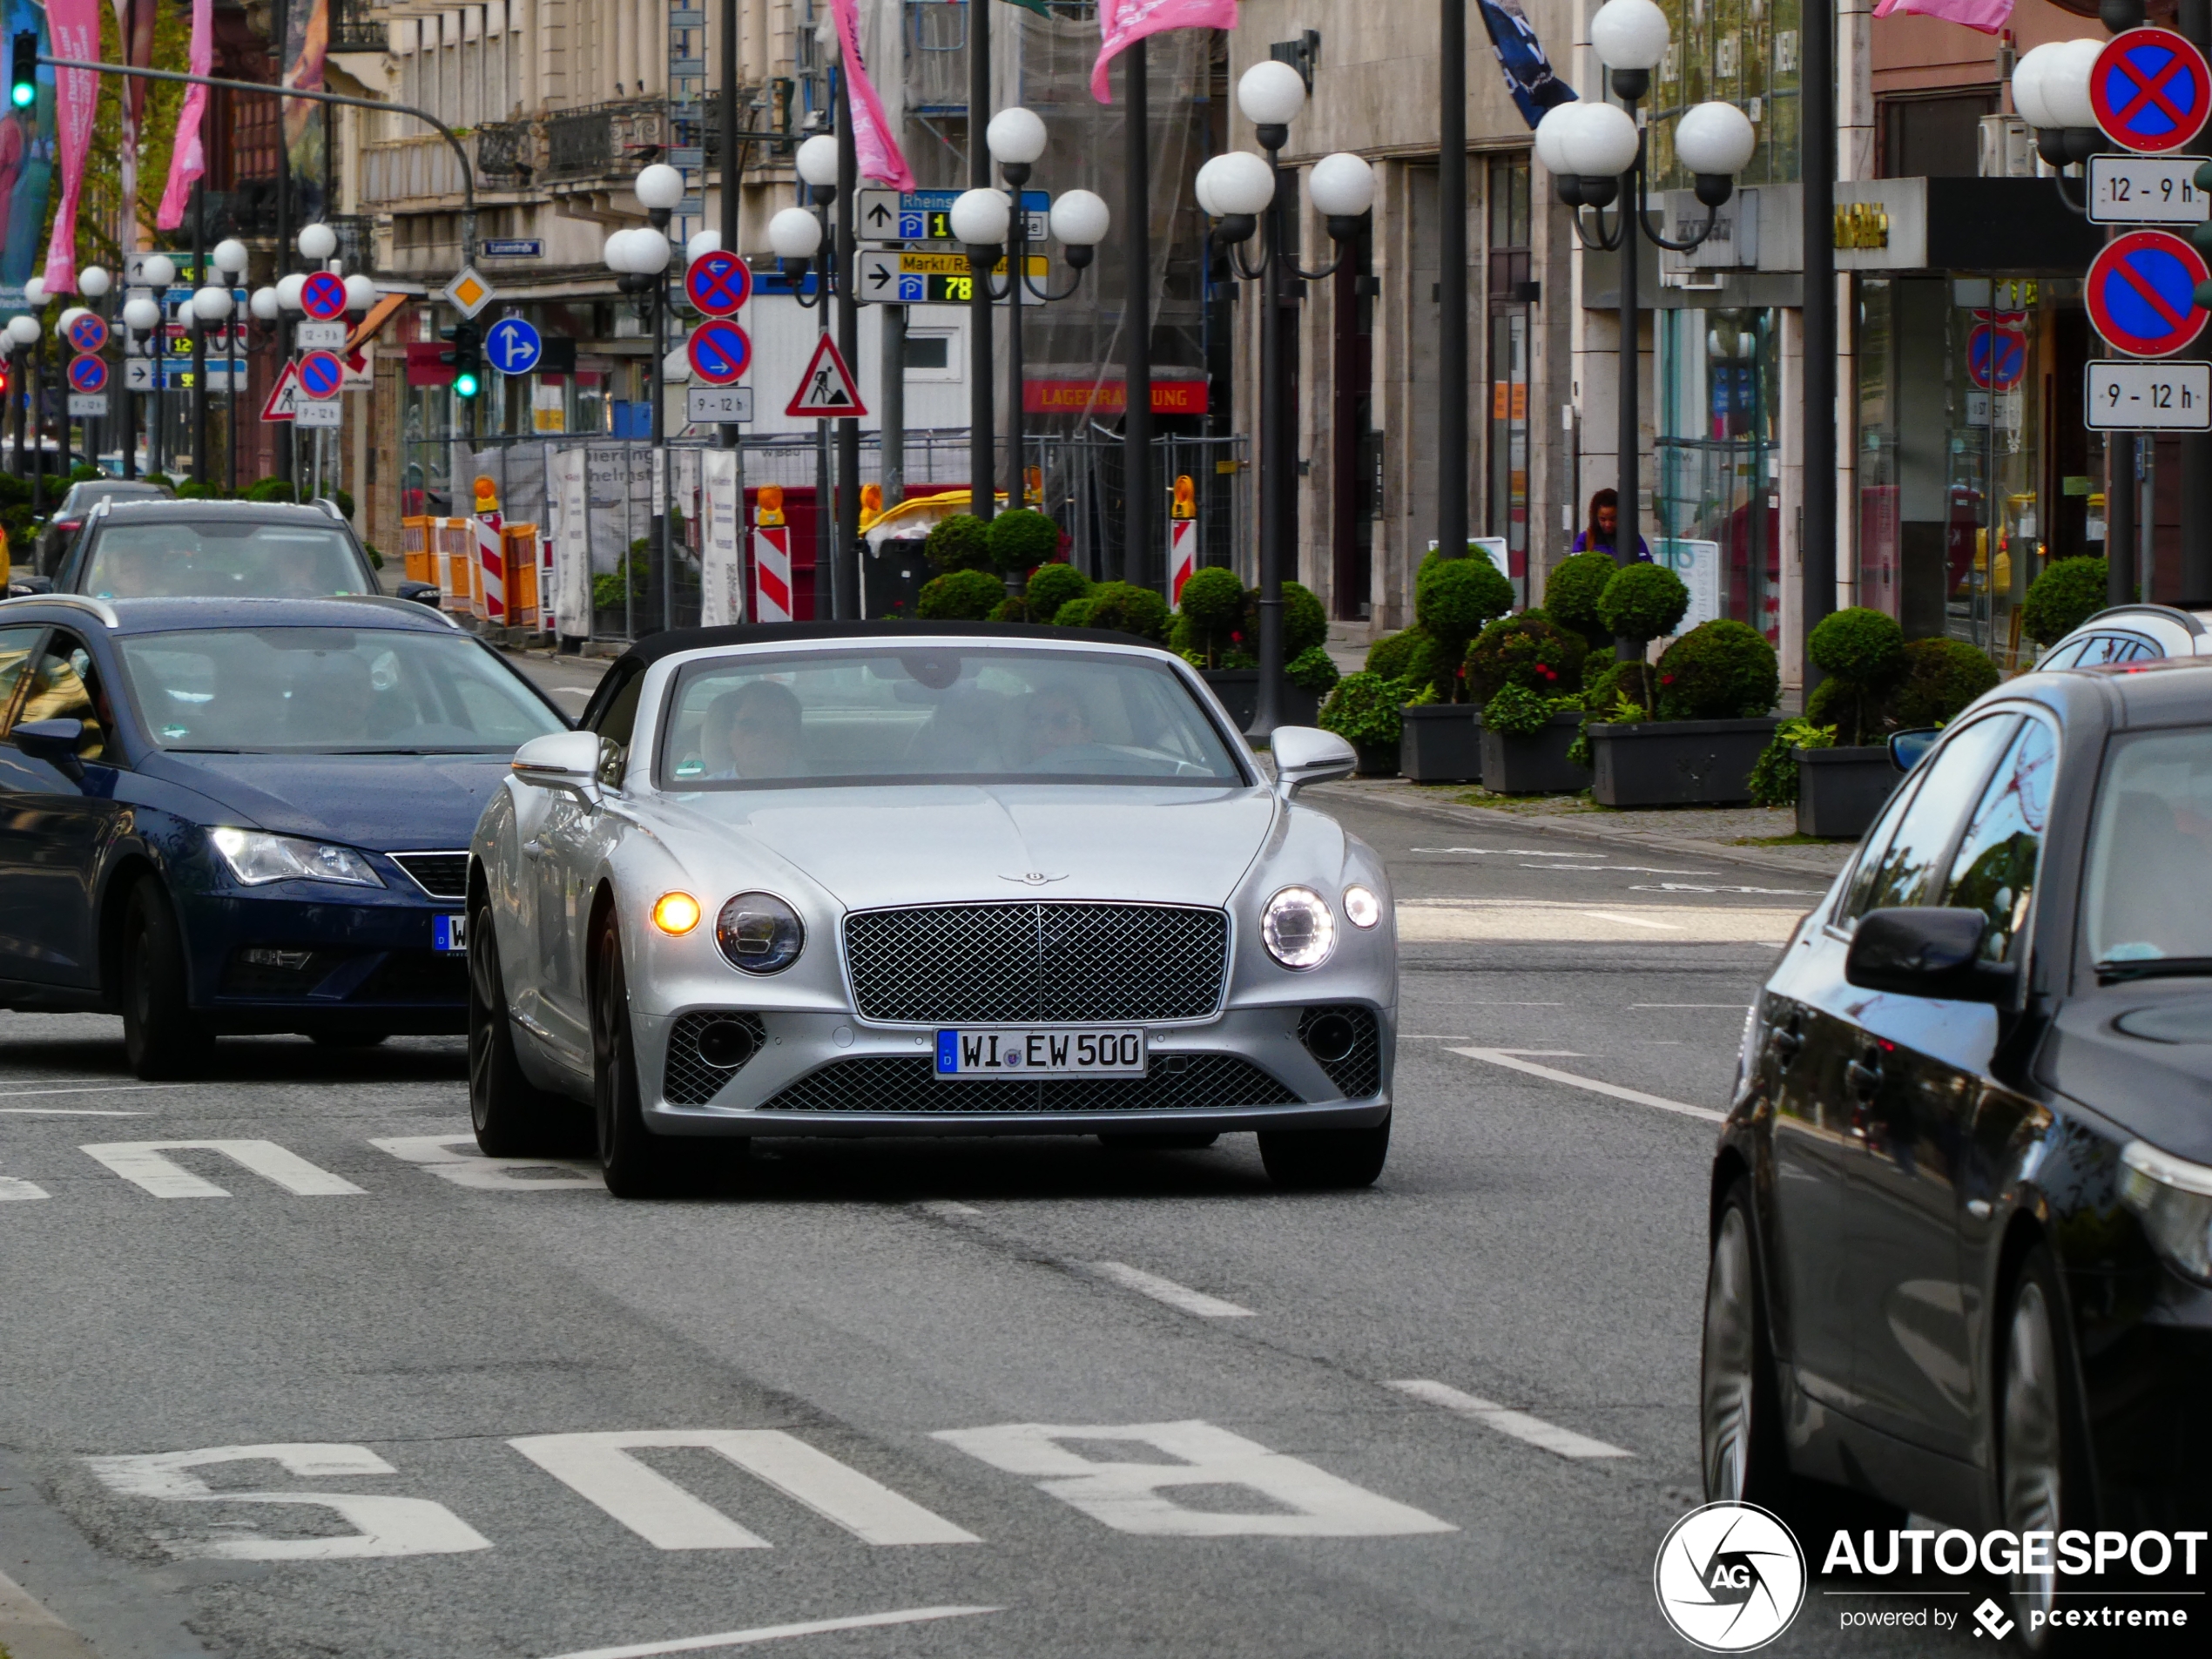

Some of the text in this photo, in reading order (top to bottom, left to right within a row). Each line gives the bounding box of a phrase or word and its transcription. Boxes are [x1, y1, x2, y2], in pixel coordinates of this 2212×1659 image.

[2110, 177, 2130, 202] 12
[2161, 178, 2173, 202] 9
[2182, 179, 2192, 203] h
[698, 398, 705, 412] 9
[720, 398, 732, 412] 12
[737, 398, 743, 412] h
[2108, 383, 2121, 408] 9
[2151, 383, 2172, 408] 12
[2182, 384, 2192, 409] h
[438, 920, 467, 947] D W
[943, 1055, 953, 1065] D
[962, 1035, 1001, 1067] WI
[87, 1420, 1460, 1561] BUS
